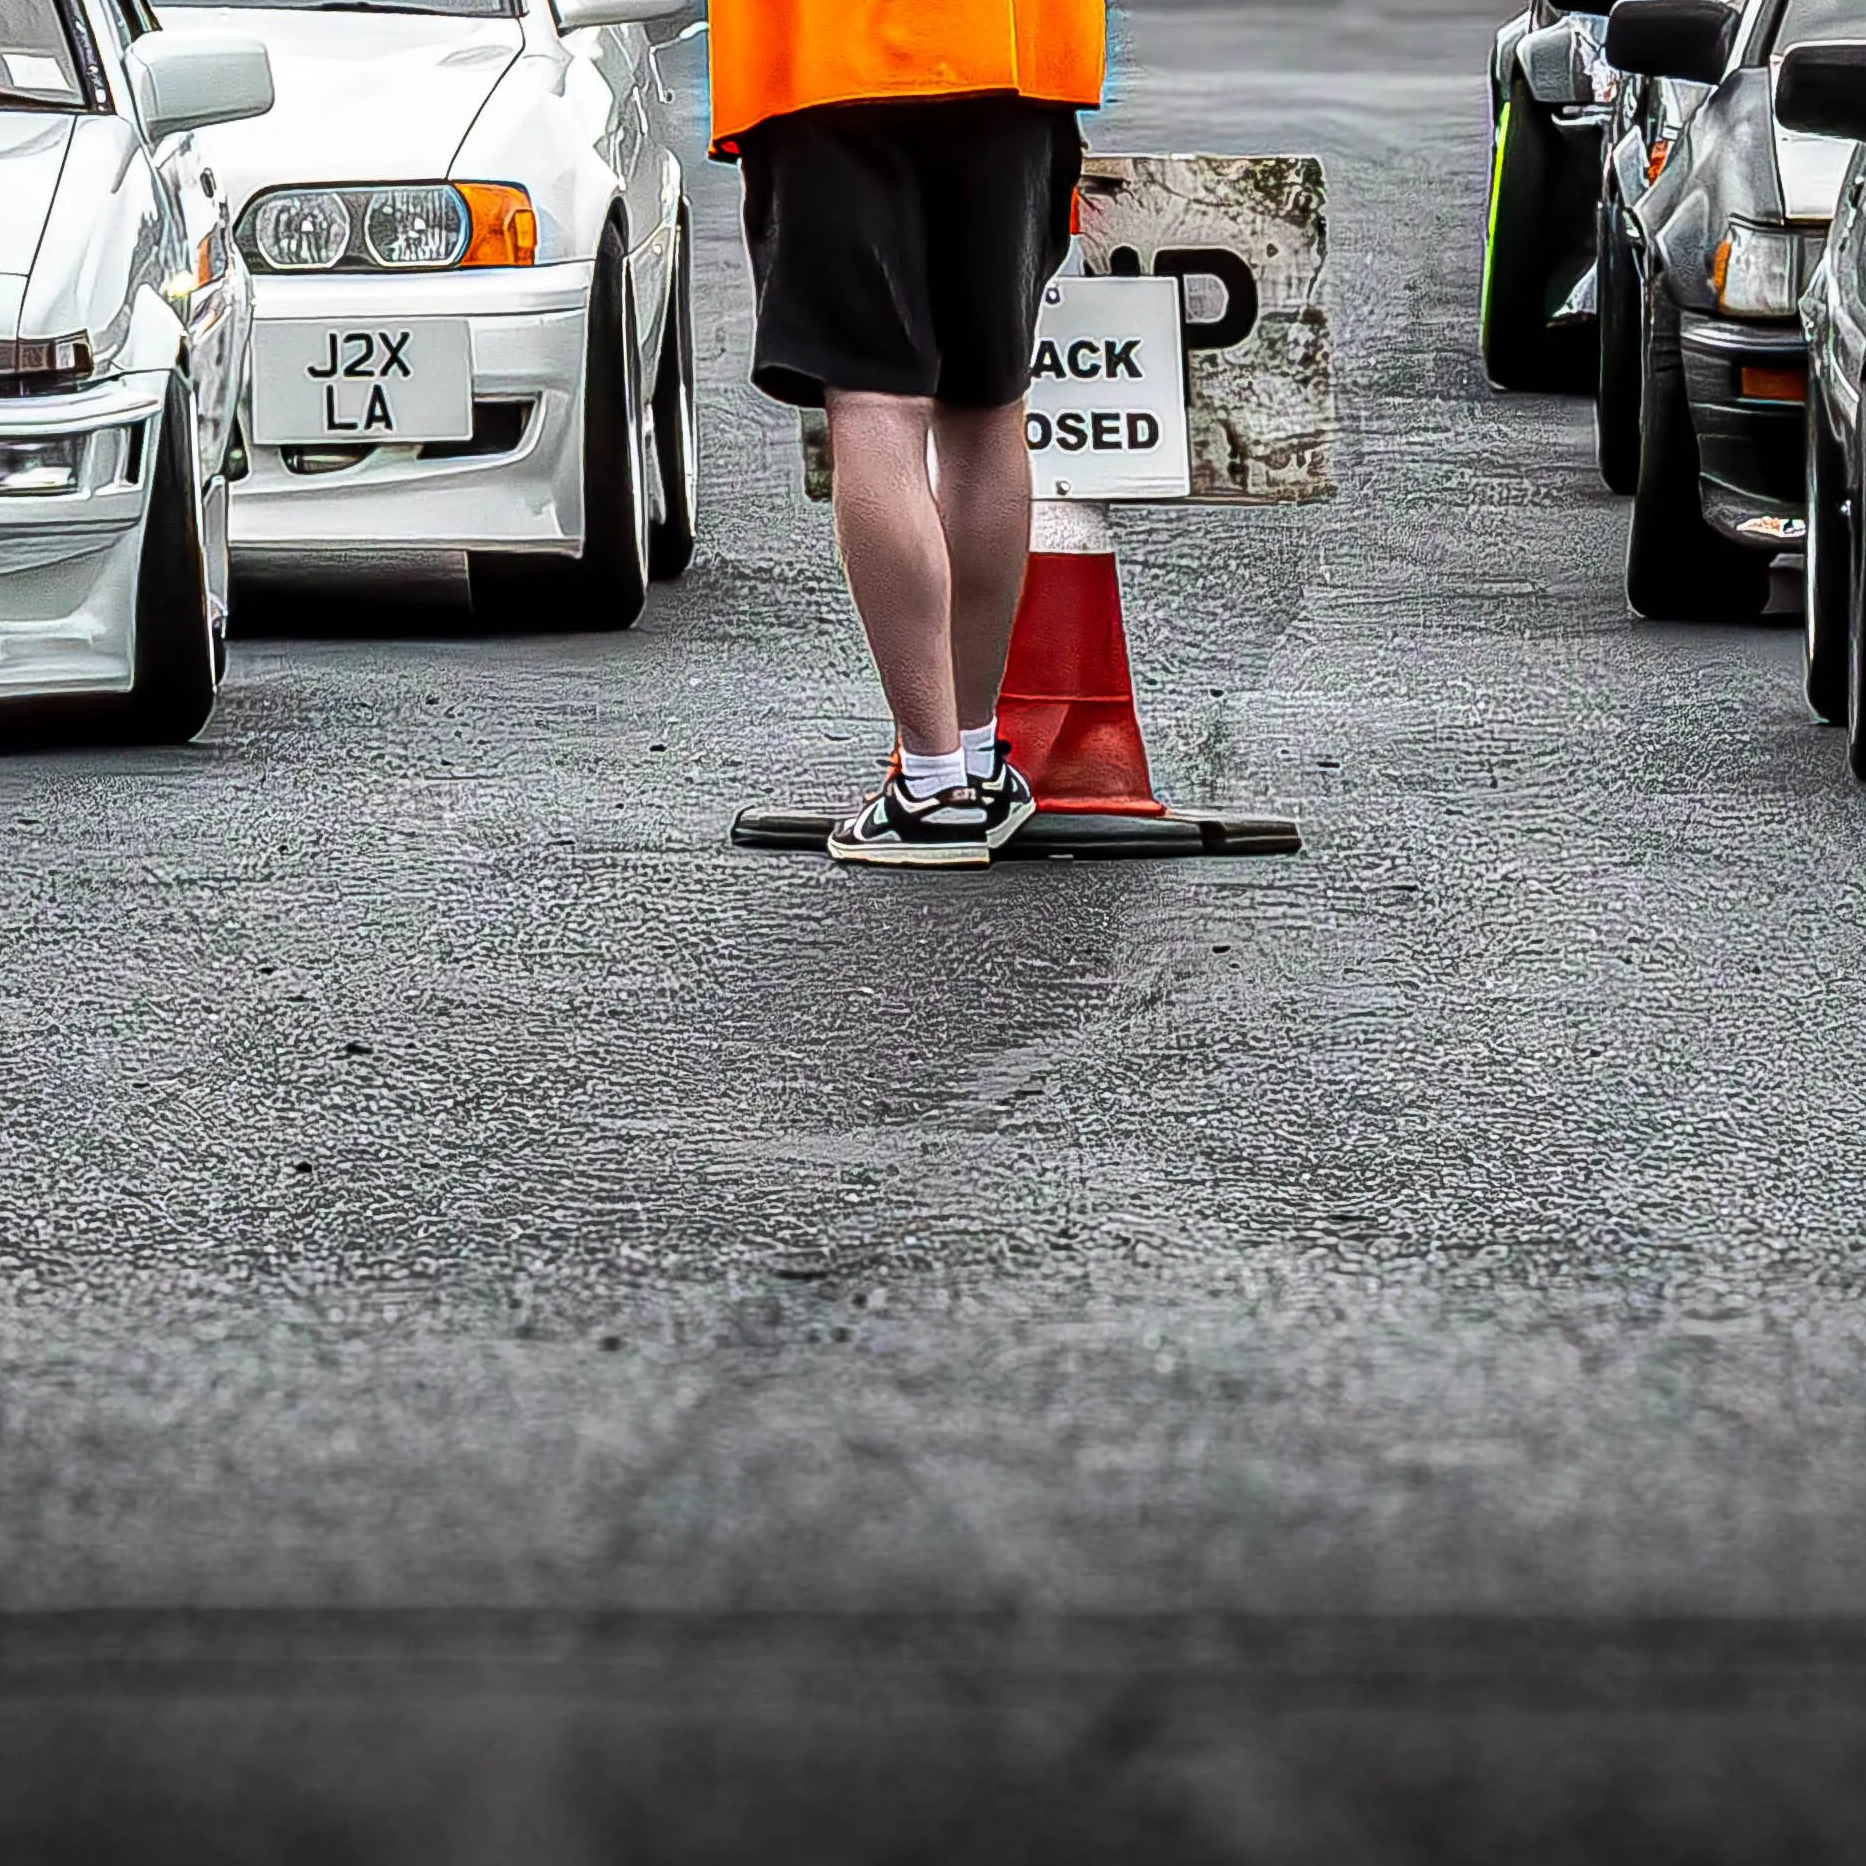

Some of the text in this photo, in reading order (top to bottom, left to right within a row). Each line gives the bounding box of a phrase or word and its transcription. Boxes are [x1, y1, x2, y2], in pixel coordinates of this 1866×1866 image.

[1108, 246, 1258, 409] P
[306, 330, 412, 379] J2X
[1030, 338, 1144, 380] ACK
[325, 383, 394, 431] LA
[1025, 411, 1160, 452] OSED
